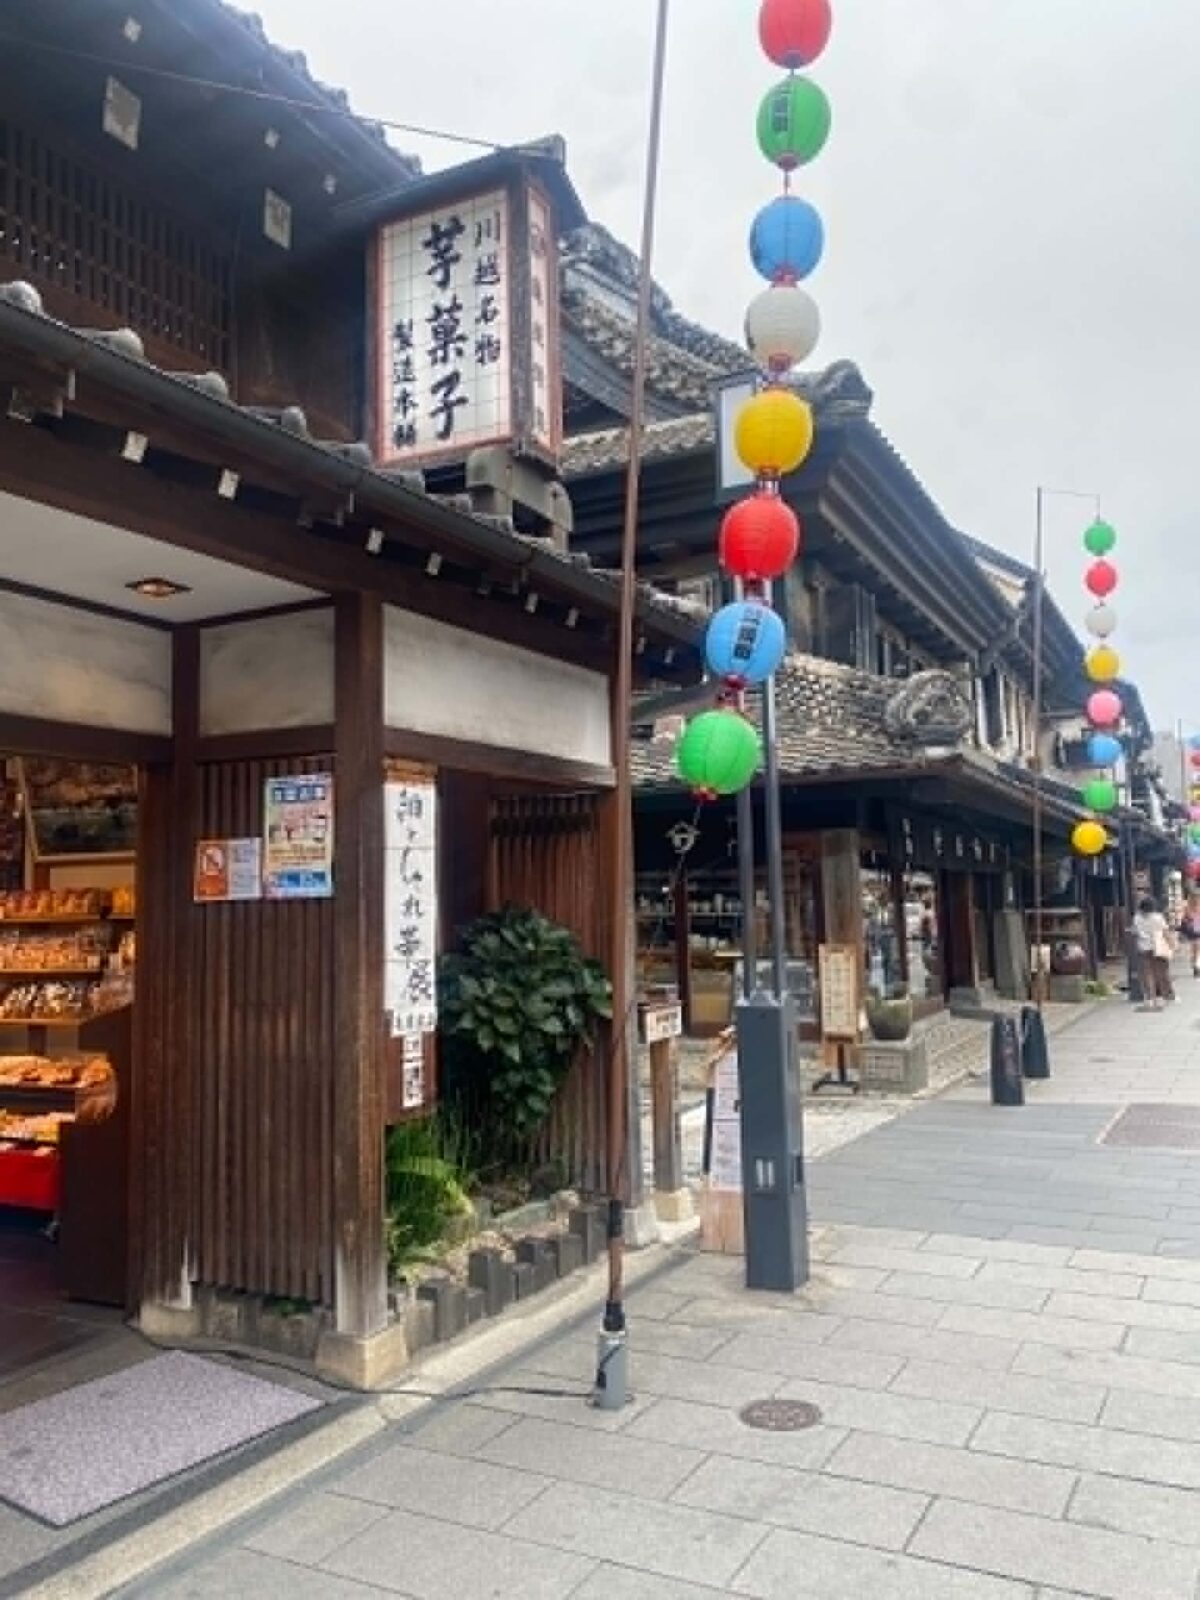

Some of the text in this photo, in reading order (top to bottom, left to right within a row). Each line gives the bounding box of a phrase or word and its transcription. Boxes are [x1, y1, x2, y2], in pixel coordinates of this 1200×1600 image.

[422, 215, 469, 440] 芋菓子
[473, 211, 501, 367] 川越名物
